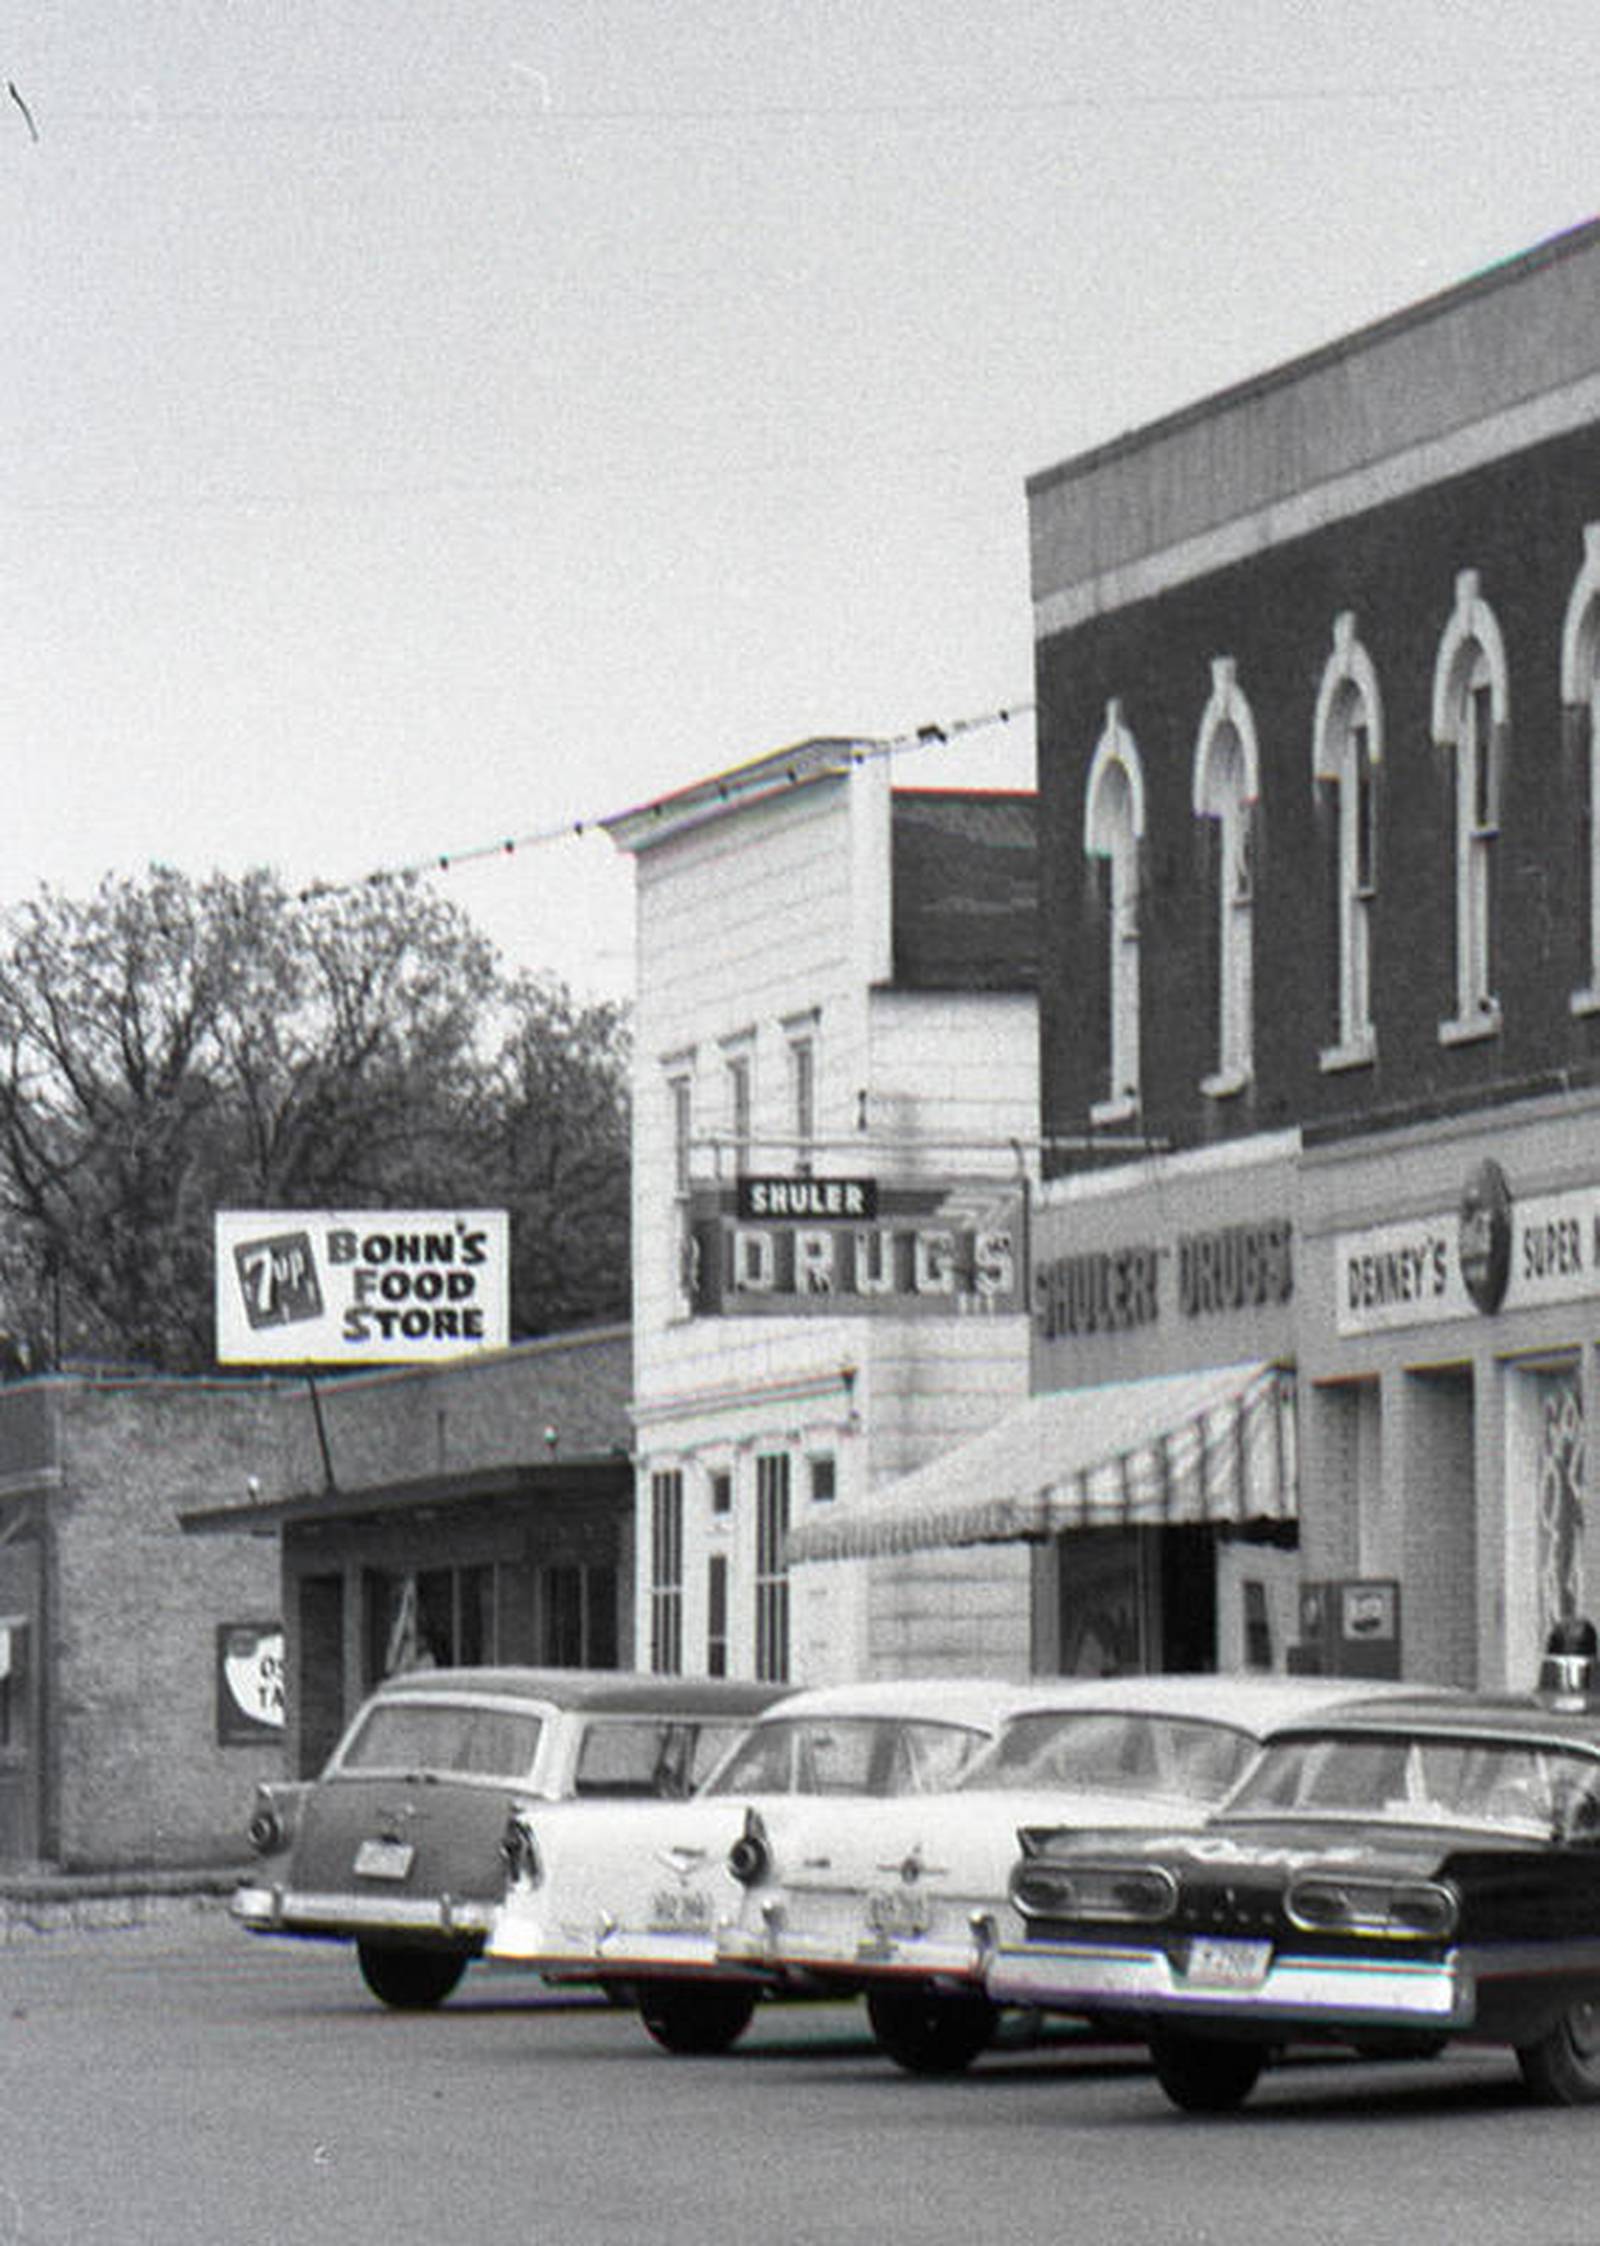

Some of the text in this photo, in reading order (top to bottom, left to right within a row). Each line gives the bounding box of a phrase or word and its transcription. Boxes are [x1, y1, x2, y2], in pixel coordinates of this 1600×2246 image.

[751, 1184, 865, 1213] SHULER
[327, 1220, 487, 1265] BOHN'S
[1524, 1219, 1583, 1280] SUPER
[733, 1231, 1014, 1295] DRUGS
[353, 1269, 476, 1304] FOOD
[342, 1307, 484, 1341] STORE
